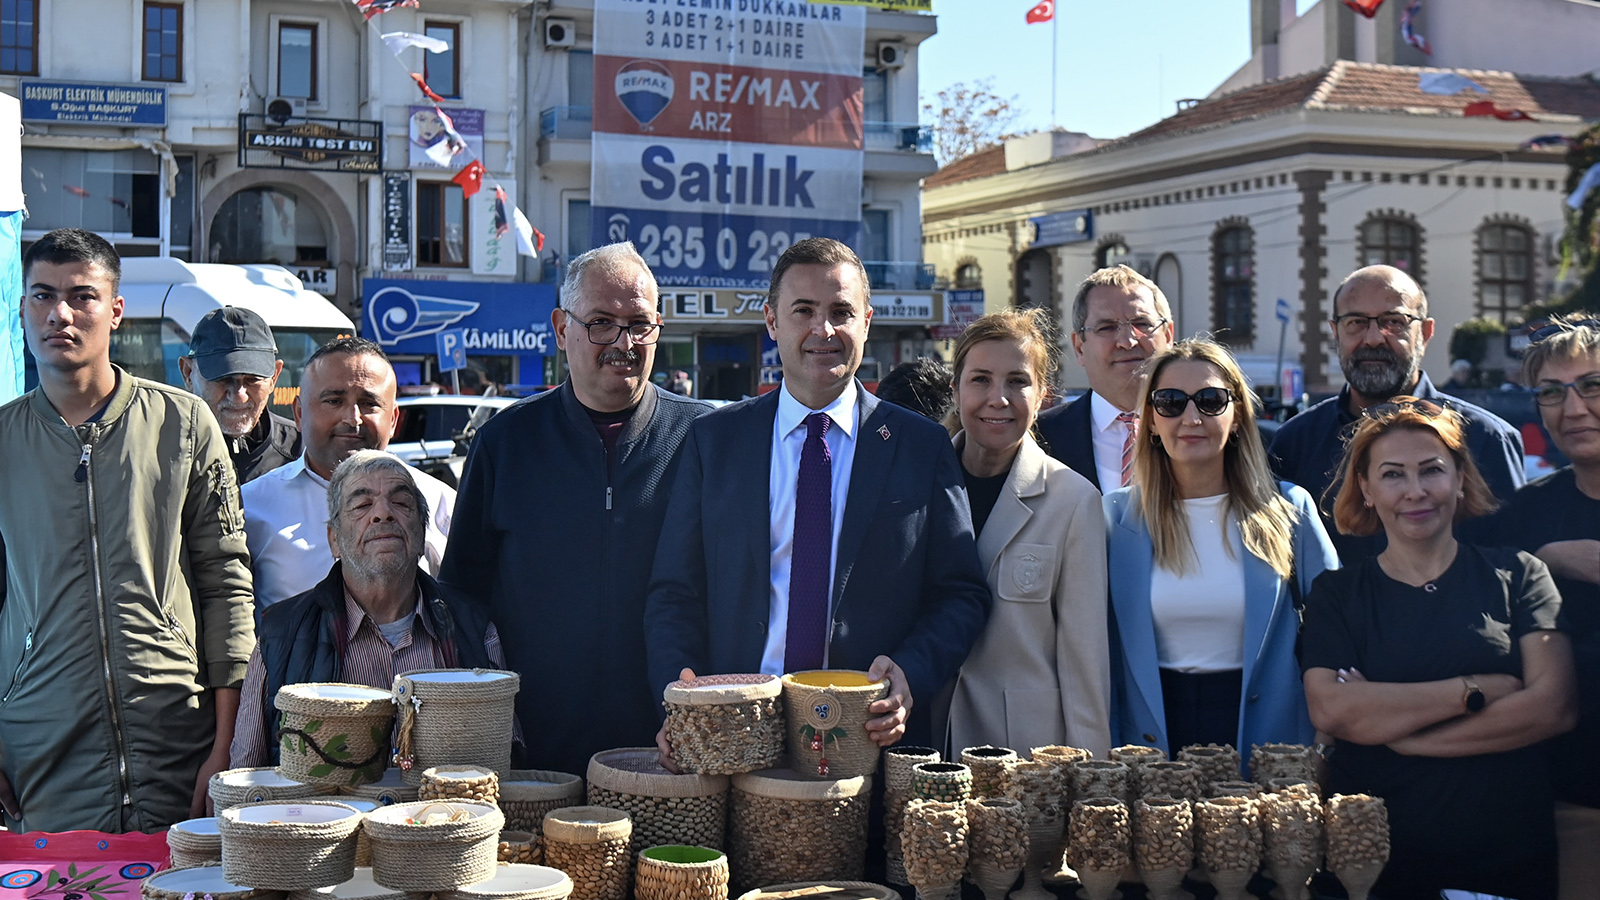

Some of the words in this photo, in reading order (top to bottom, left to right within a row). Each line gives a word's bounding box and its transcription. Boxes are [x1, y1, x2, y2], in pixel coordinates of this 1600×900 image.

[646, 9, 655, 25] 3
[661, 11, 707, 29] ADET
[753, 18, 805, 38] DAİRE
[646, 31, 655, 46] 3
[661, 32, 707, 50] ADET
[753, 39, 804, 59] DAİRE
[25, 86, 64, 100] BAŞKURT
[66, 87, 105, 102] ELEKTRİK
[107, 88, 163, 105] MÜHENDİSLİK
[623, 76, 667, 91] RE/MAX
[689, 70, 820, 111] RE/MAX
[689, 111, 732, 132] ARZ
[253, 134, 303, 147] AŞKIN
[308, 138, 345, 149] TOST
[640, 144, 815, 209] Satılık
[639, 224, 706, 269] 235
[716, 227, 738, 271] 0
[444, 334, 457, 357] P
